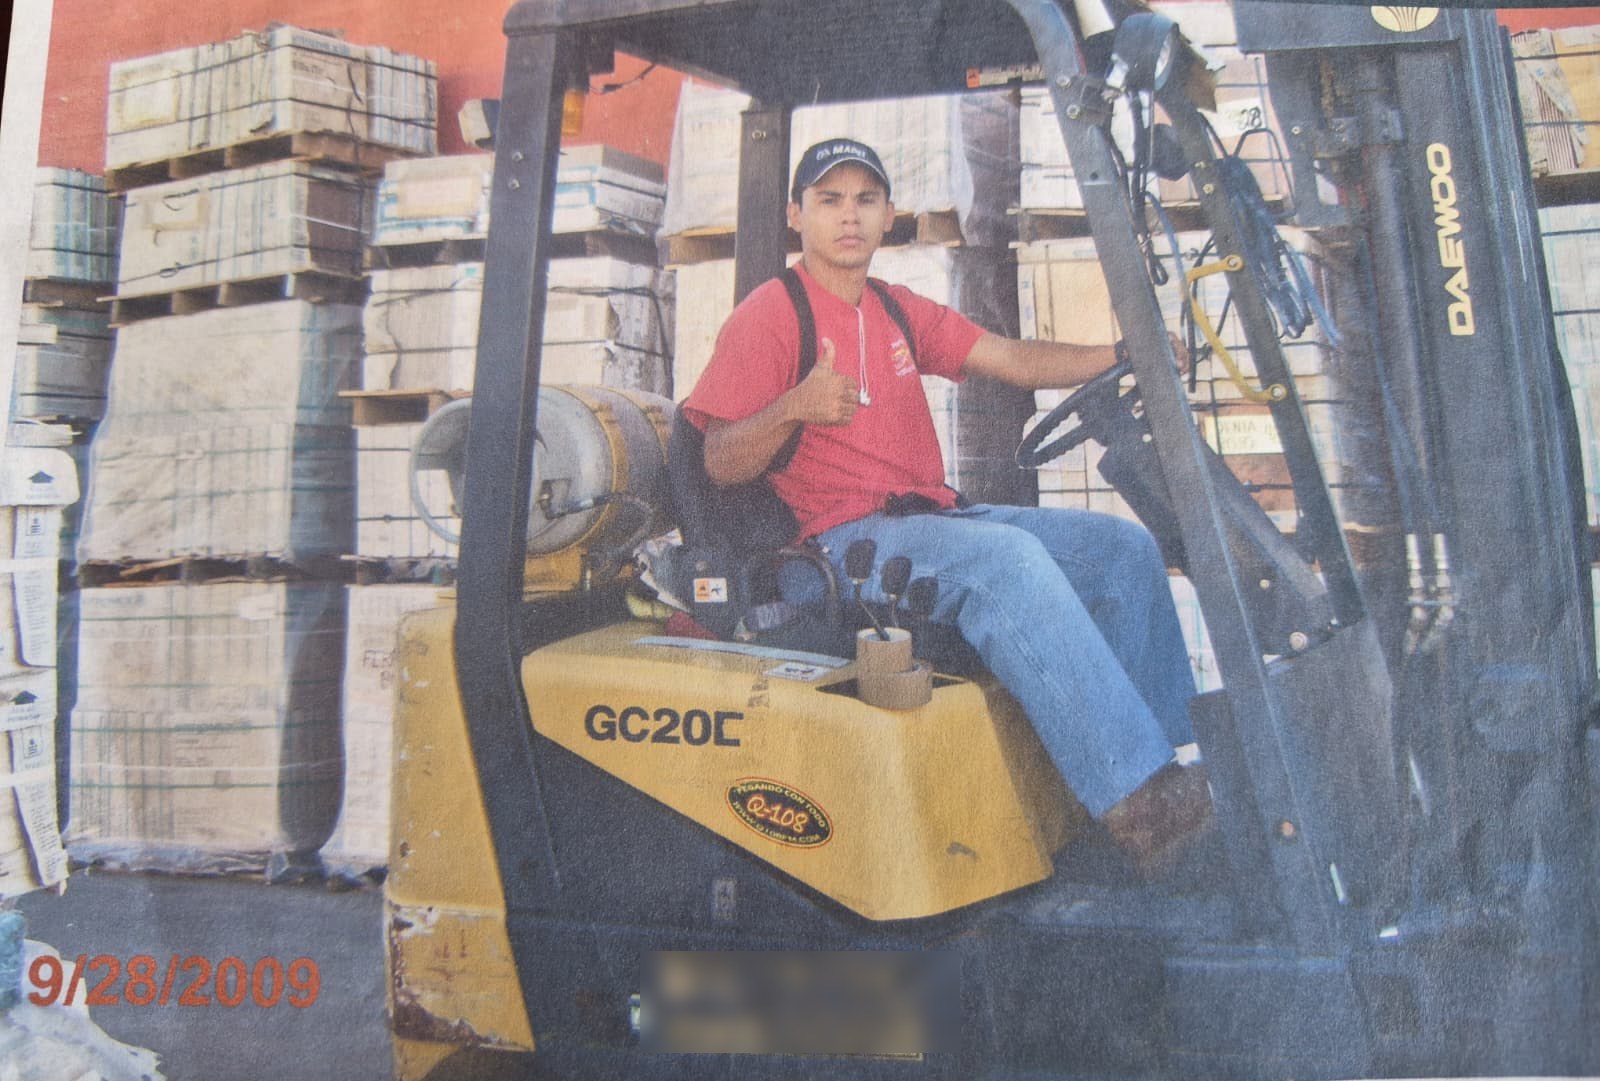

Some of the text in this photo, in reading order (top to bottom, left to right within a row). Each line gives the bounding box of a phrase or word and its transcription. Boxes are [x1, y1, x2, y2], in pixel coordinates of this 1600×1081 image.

[1426, 142, 1475, 336] DAEWOO
[746, 794, 808, 833] Q-108
[784, 789, 806, 805] CON
[805, 803, 827, 828] TODO
